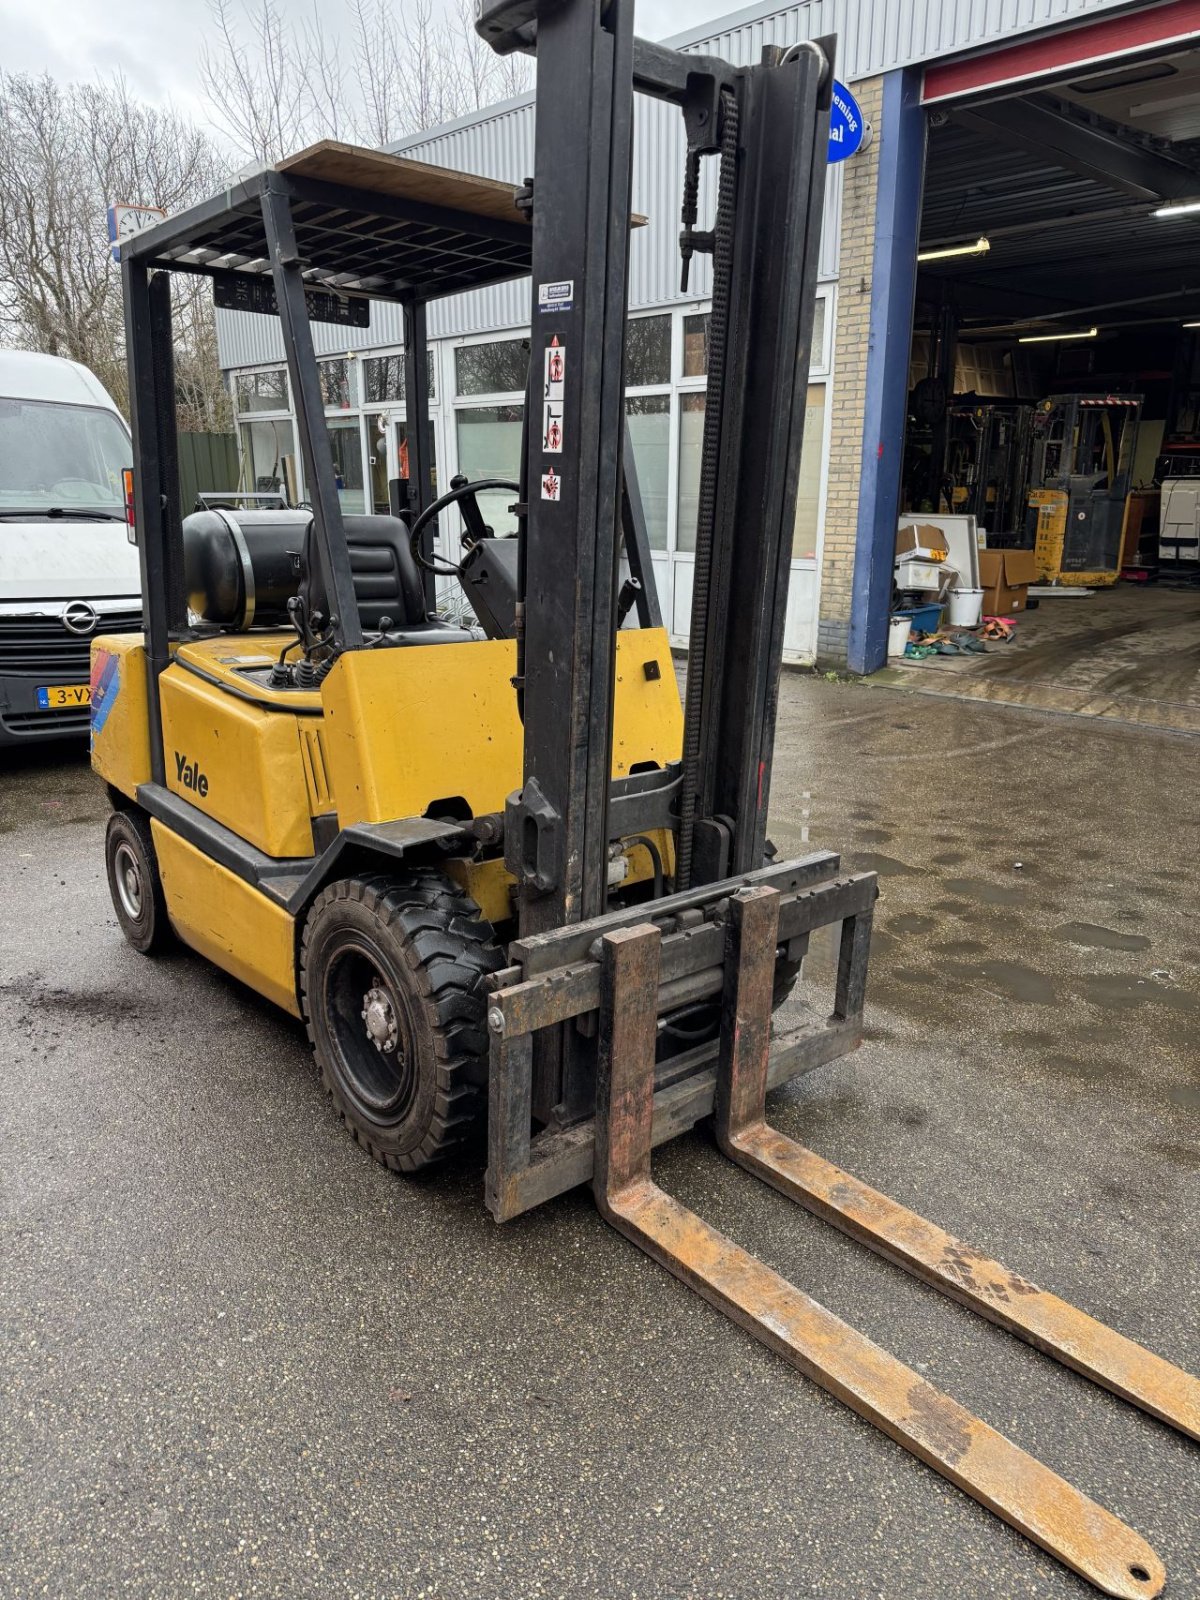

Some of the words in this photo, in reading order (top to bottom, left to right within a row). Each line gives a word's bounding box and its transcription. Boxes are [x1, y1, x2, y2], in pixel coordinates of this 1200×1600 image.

[832, 92, 858, 132] eming
[829, 124, 844, 143] al
[174, 750, 209, 798] Yale
